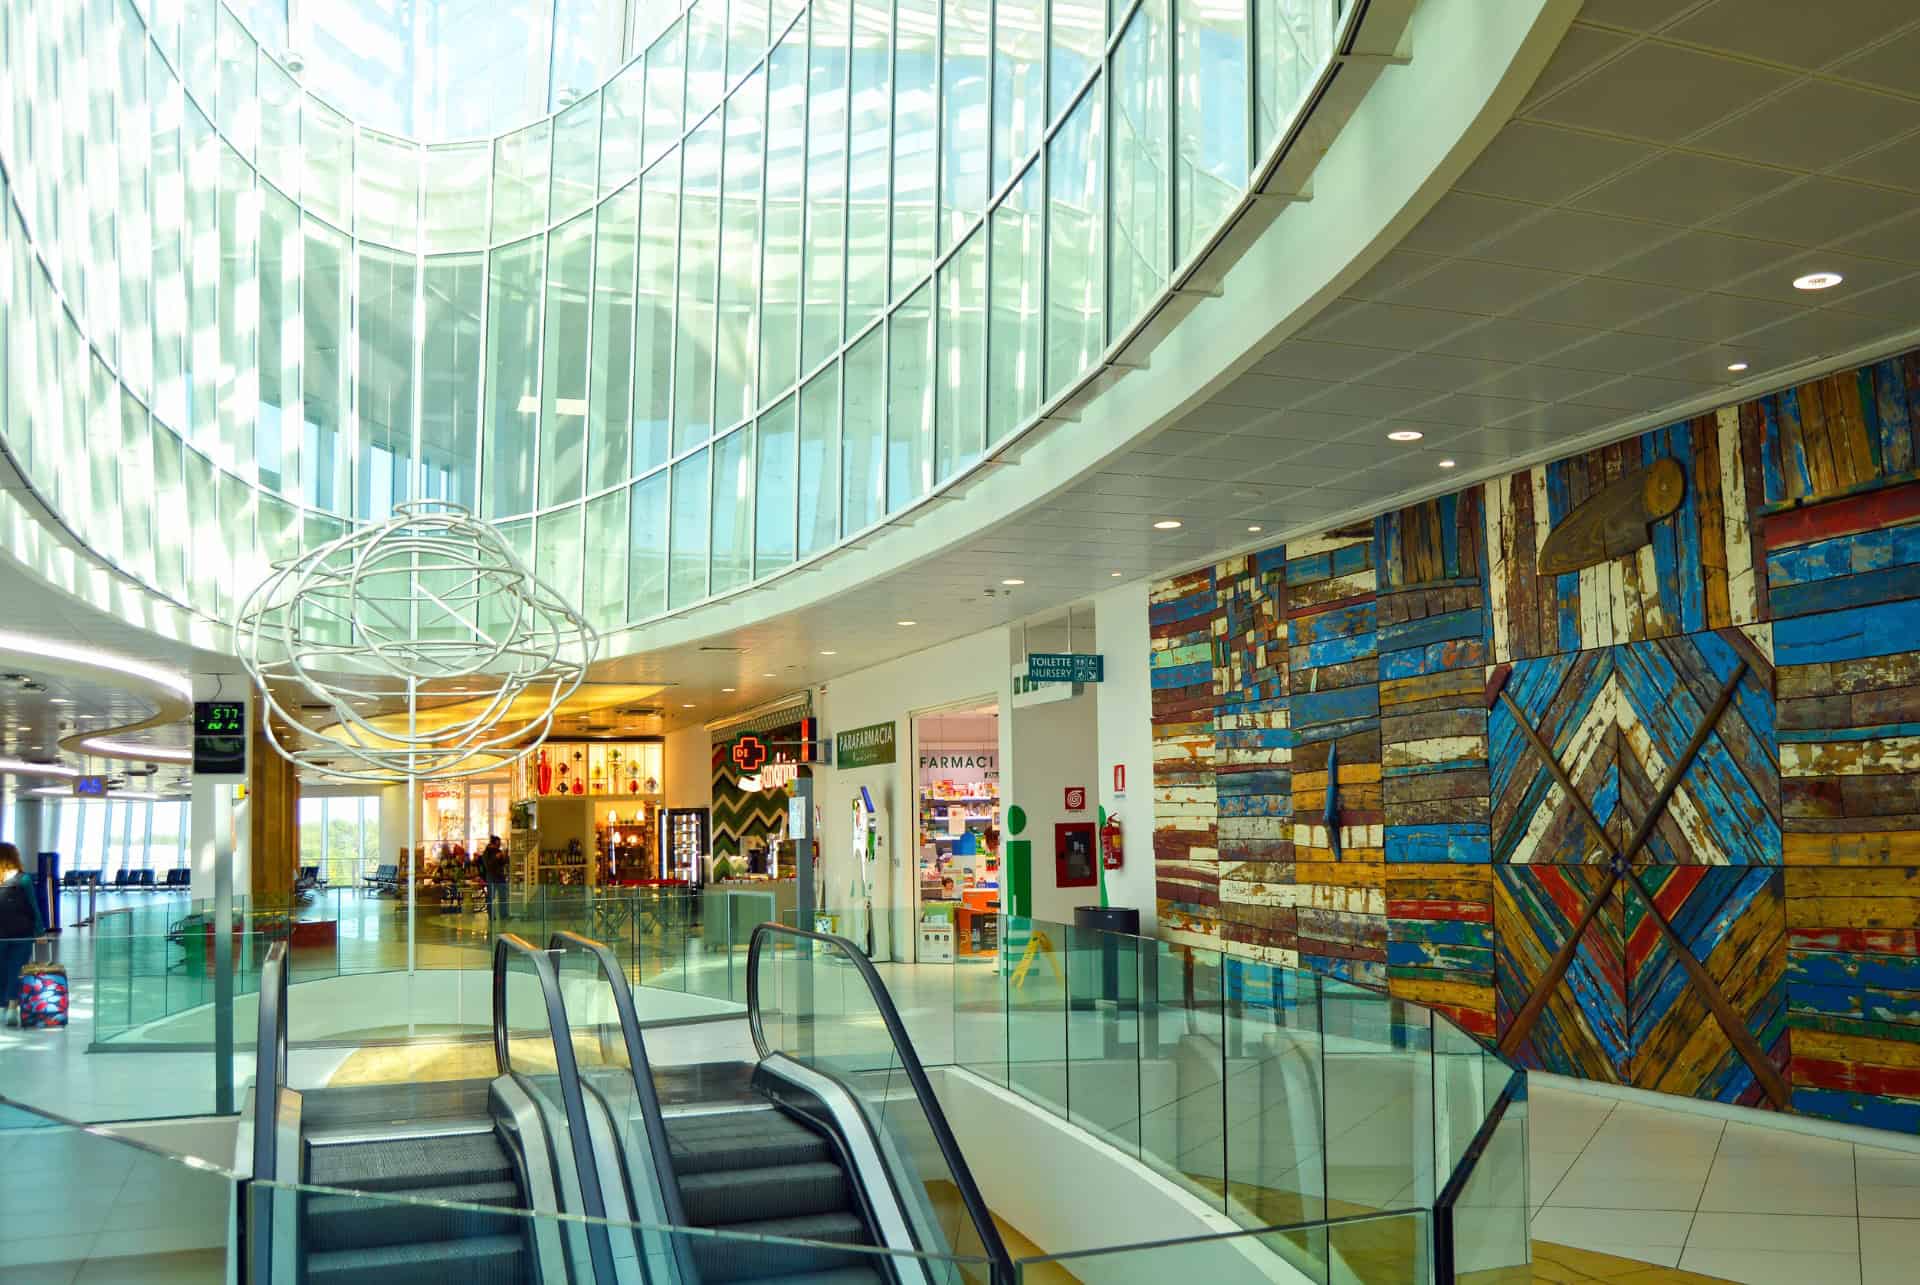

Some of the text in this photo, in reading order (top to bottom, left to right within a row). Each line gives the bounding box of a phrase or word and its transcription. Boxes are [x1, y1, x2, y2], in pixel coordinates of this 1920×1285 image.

[1031, 657, 1072, 667] TOILETTE
[1031, 668, 1072, 678] NURSERY
[213, 708, 238, 720] 577
[839, 726, 893, 752] PARAFARMACIA
